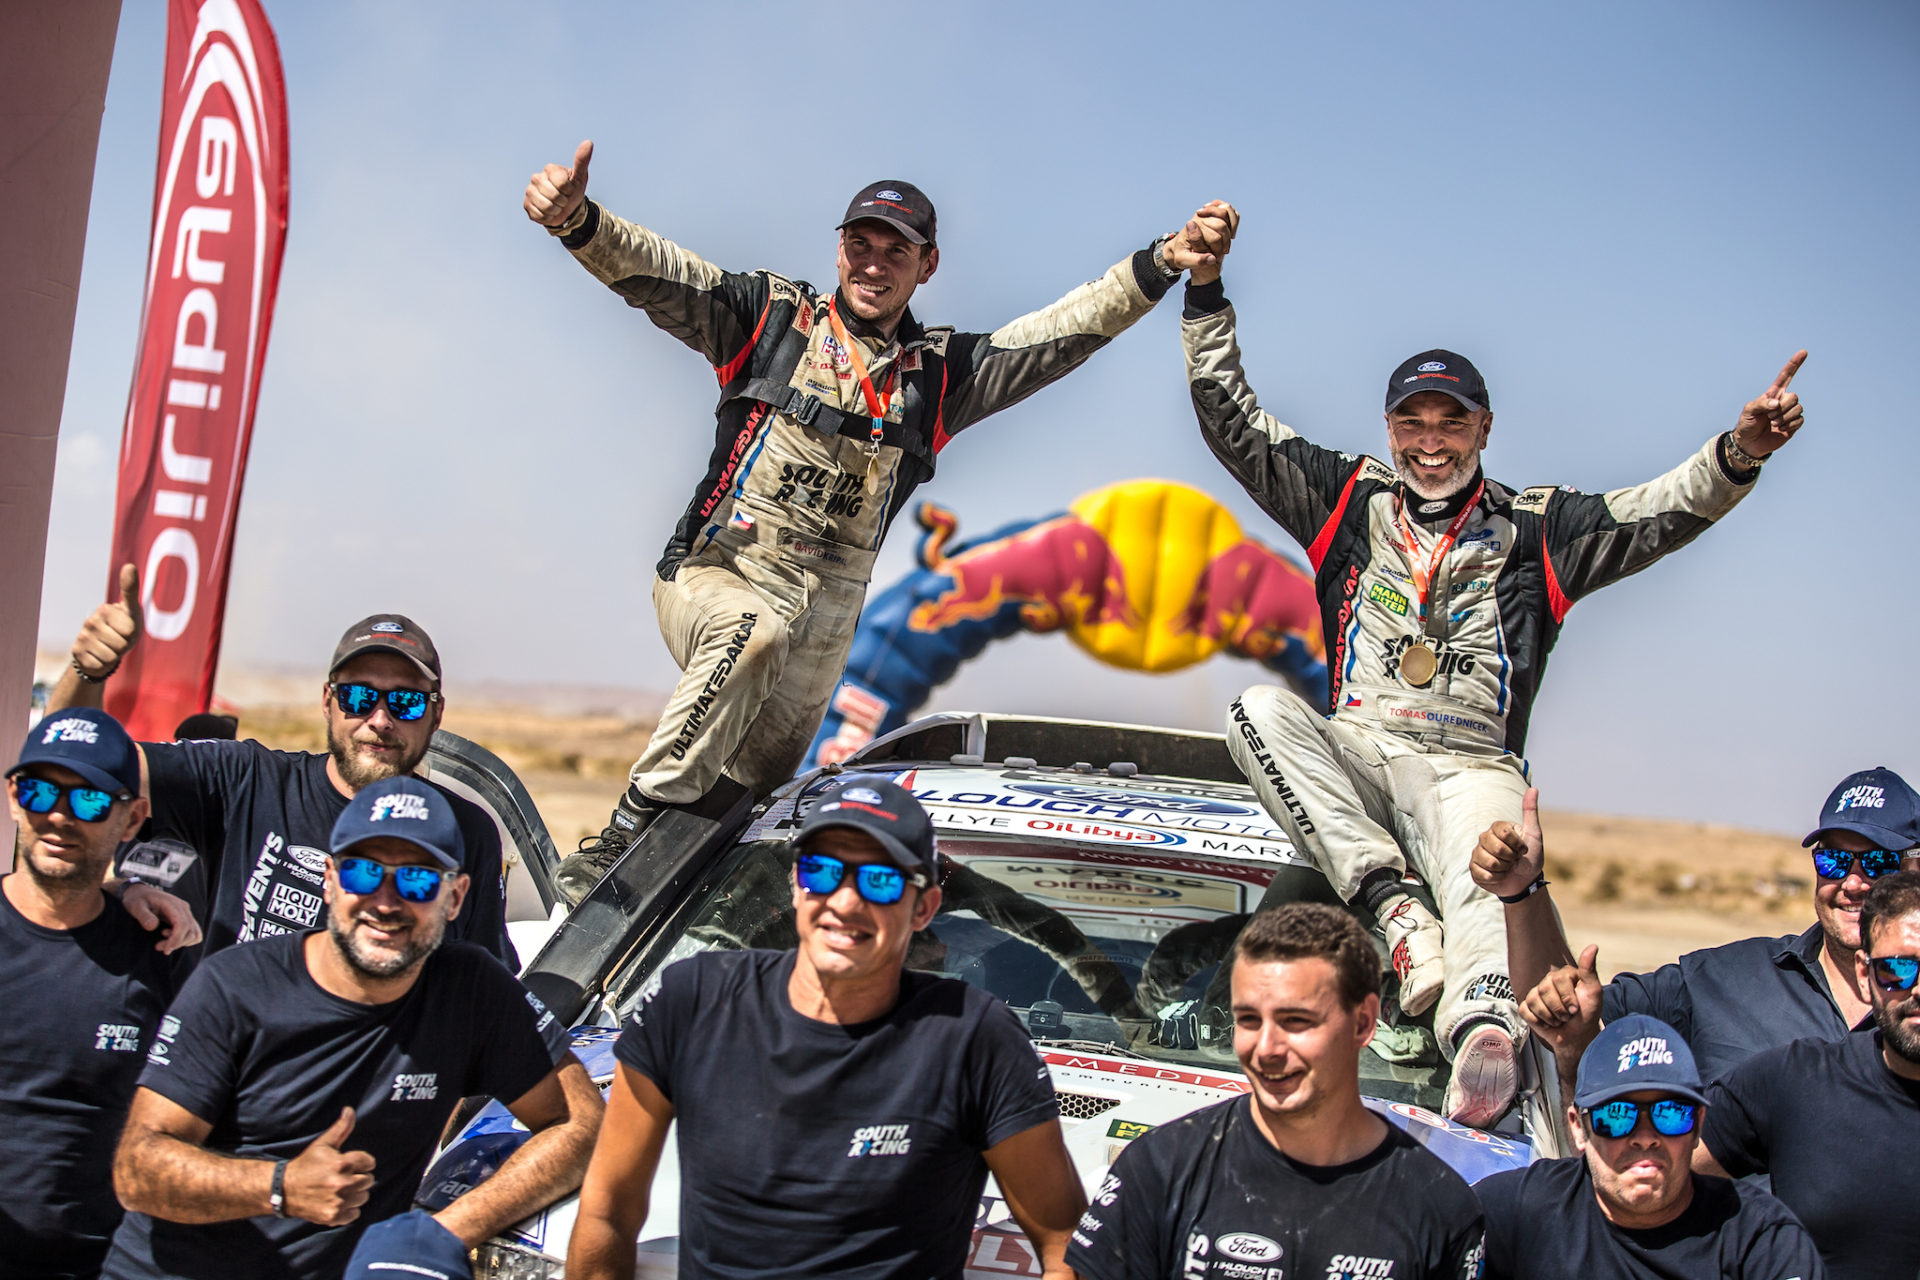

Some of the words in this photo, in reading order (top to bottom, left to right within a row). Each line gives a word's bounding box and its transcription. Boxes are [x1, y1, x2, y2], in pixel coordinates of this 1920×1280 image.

[1366, 465, 1395, 480] OMP
[1516, 493, 1545, 504] OMP
[1370, 591, 1406, 615] FILTER
[1373, 585, 1408, 607] MANN
[1053, 787, 1210, 812] Ford
[1842, 785, 1885, 801] SOUTH
[911, 789, 1134, 819] LOUCH
[1143, 811, 1290, 840] MOTO
[929, 812, 1011, 827] LLYE
[1027, 819, 1157, 842] OiLibya
[1202, 840, 1302, 861] MAR
[276, 886, 319, 911] LIQUI
[269, 899, 317, 925] MOLY
[96, 1023, 140, 1039] SOUTH
[1618, 1037, 1667, 1061] SOUTH
[392, 1073, 438, 1089] SOUTH
[1066, 1057, 1245, 1093] MEDIA
[850, 1124, 909, 1144] SOUTH
[848, 1138, 912, 1158] RACING
[1229, 1237, 1269, 1257] Ford
[1325, 1254, 1395, 1278] SOUTH
